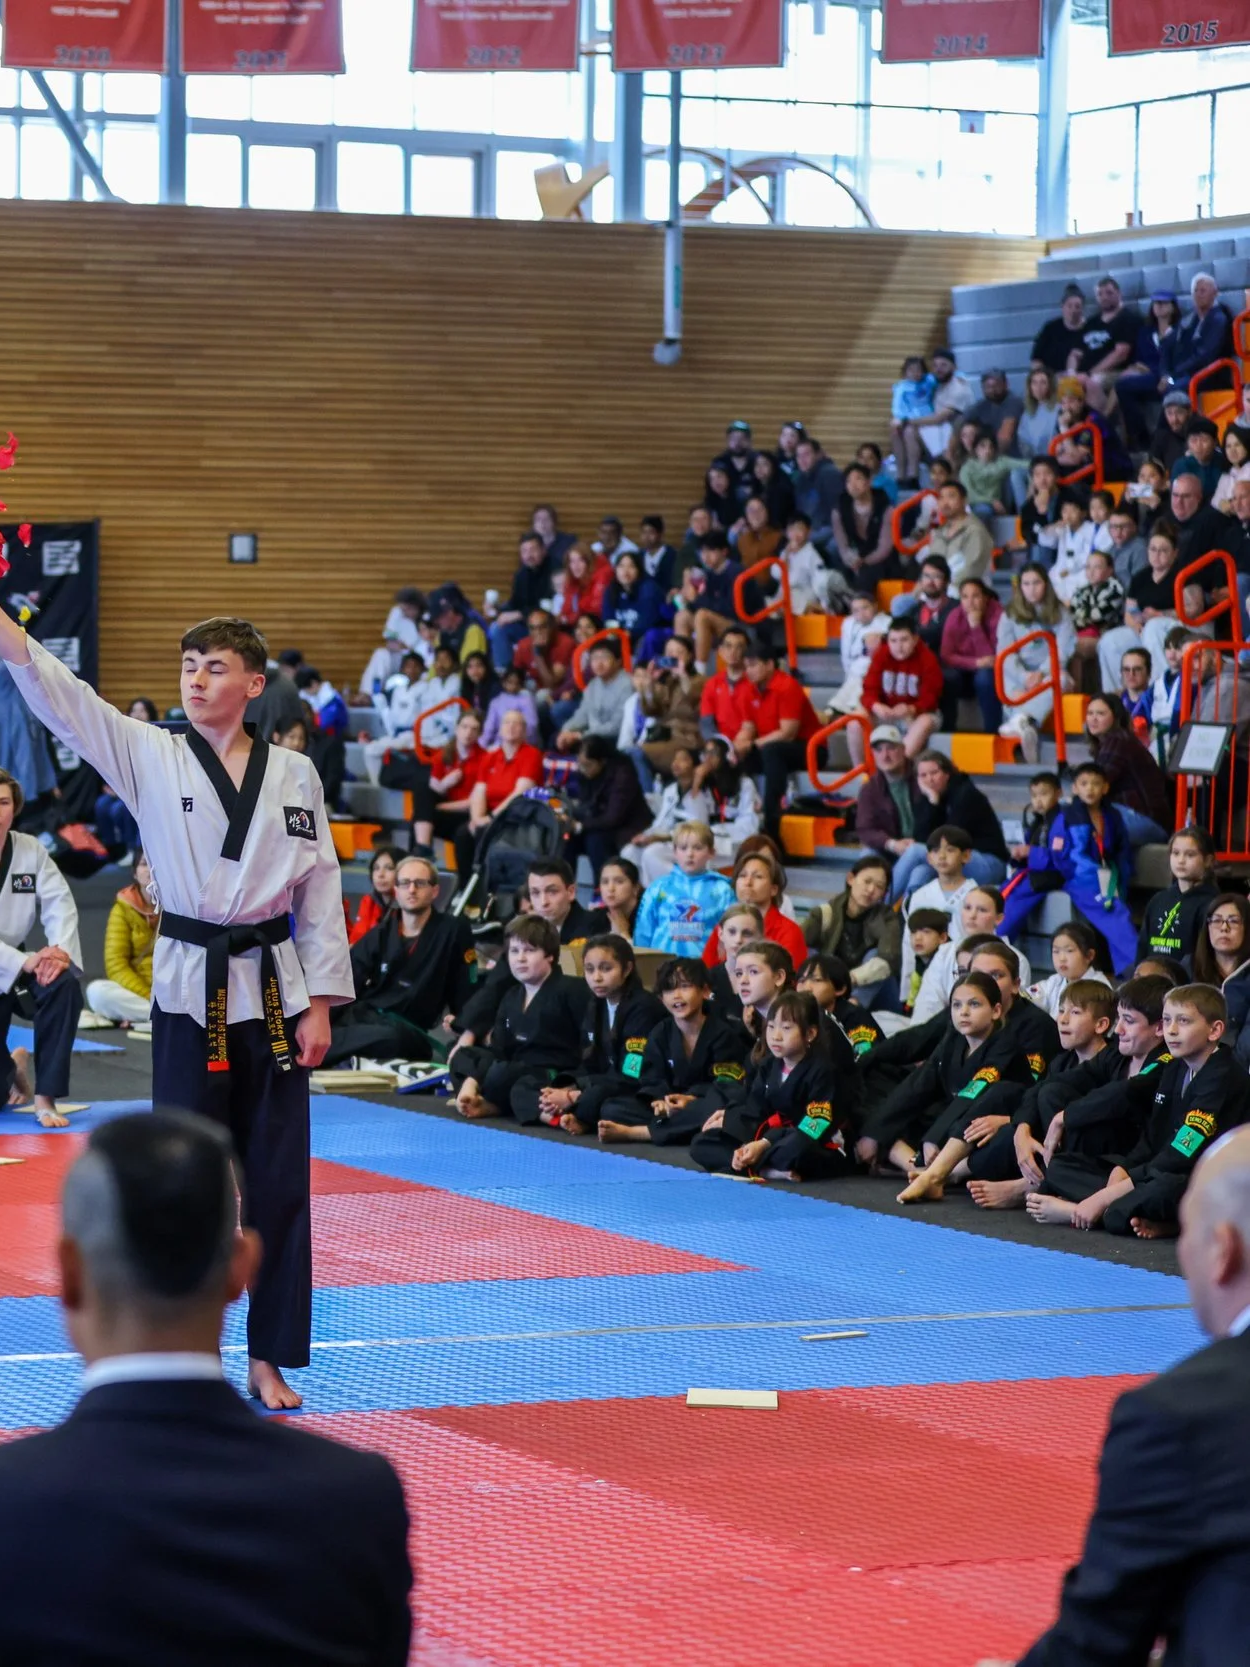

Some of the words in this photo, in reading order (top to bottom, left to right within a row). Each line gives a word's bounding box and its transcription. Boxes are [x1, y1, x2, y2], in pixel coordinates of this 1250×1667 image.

[1161, 20, 1220, 45] 2015
[666, 43, 727, 65] 2013
[932, 33, 989, 55] 2014
[54, 45, 112, 66] 2010
[465, 45, 522, 66] 2012
[217, 988, 226, 1010] MASTER
[270, 977, 279, 1007] Justus
[274, 1009, 285, 1039] Stoker
